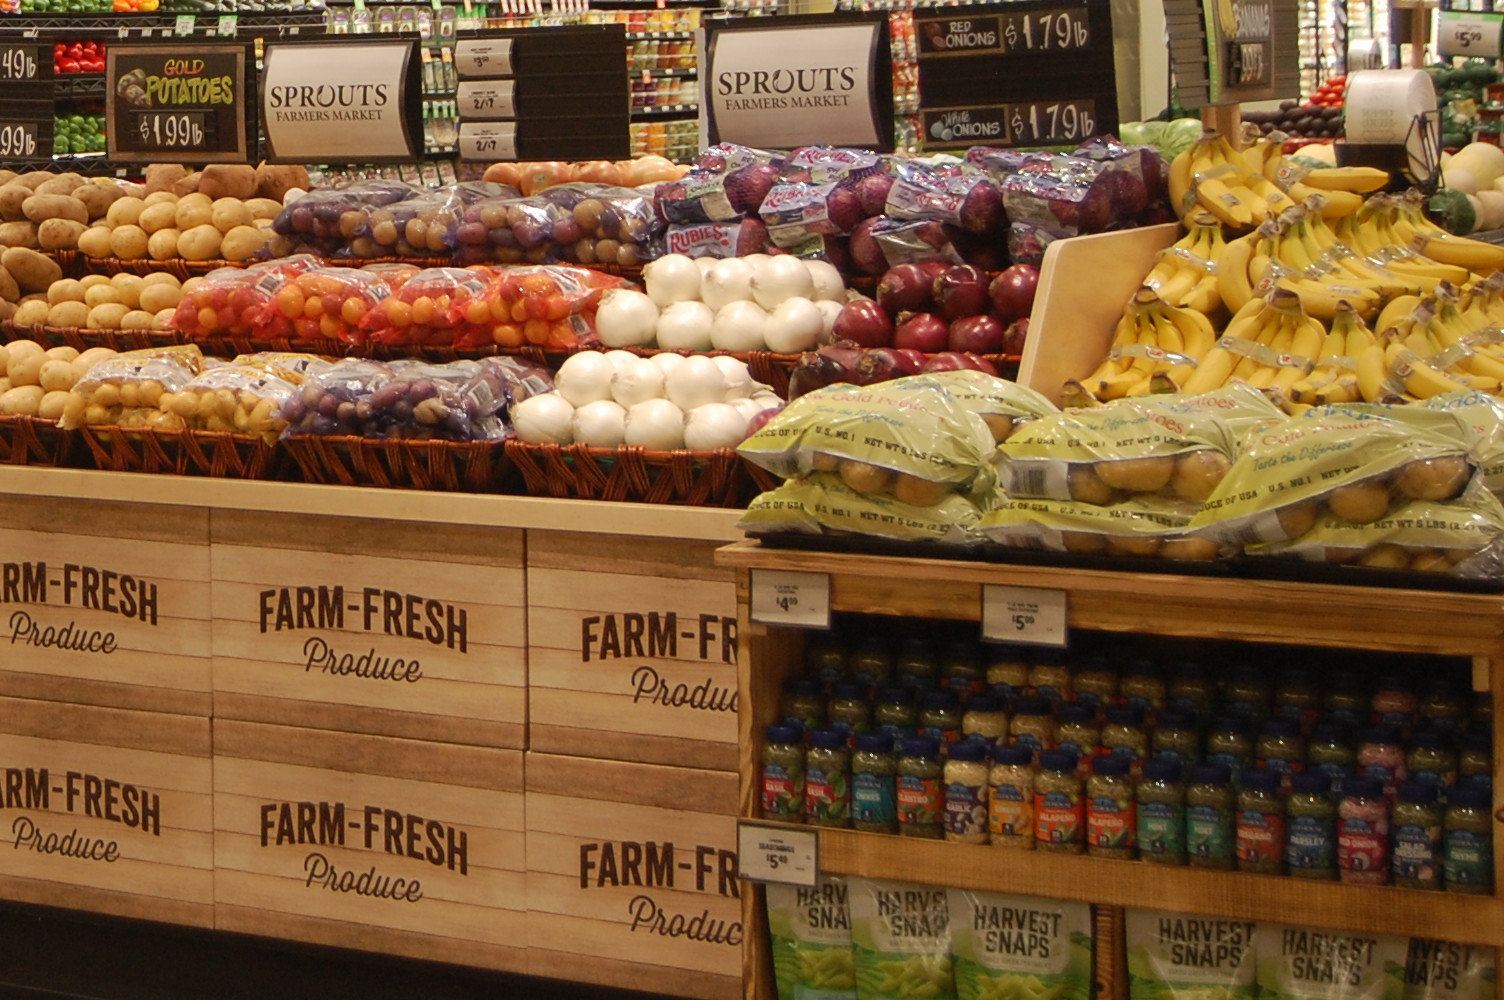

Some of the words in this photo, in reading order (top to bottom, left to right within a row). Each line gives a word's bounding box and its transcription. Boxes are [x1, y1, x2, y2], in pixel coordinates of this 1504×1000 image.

[946, 31, 996, 48] ONIONS
[949, 21, 971, 32] RED
[164, 59, 204, 75] GOLD
[145, 75, 233, 107] POTATOES
[718, 67, 855, 95] SPROUTS
[270, 83, 387, 108] SPROUTS
[725, 97, 787, 110] FARMERS
[791, 95, 850, 108] MARKET
[276, 110, 330, 122] FARMERS
[332, 109, 382, 121] MARKET
[953, 122, 1000, 136] ONIONS
[864, 437, 882, 448] NET
[885, 442, 901, 451] WT
[1239, 491, 1257, 501] USA
[1321, 469, 1340, 479] NET
[860, 511, 878, 520] NET
[880, 513, 894, 522] WT
[1374, 520, 1393, 528] NET
[1397, 520, 1413, 528] WT
[1416, 520, 1423, 528] 5
[1426, 520, 1446, 528] LBS
[8, 611, 117, 655] Produce
[259, 585, 467, 654] FARM-FRESH
[302, 637, 423, 684] Produce
[765, 783, 784, 792] BASIL
[11, 817, 121, 864] Produce
[260, 802, 468, 876] FARM-FRESH
[303, 853, 423, 903] Produce
[797, 884, 847, 906] HARV
[628, 895, 743, 946] Produc
[974, 905, 1062, 938] HARVEST
[1159, 918, 1256, 947] HARVEST
[985, 931, 1050, 958] SNAPS
[1172, 943, 1242, 968] SNAPS
[1283, 929, 1377, 965] HARVEST
[1292, 956, 1362, 986] SNAPS
